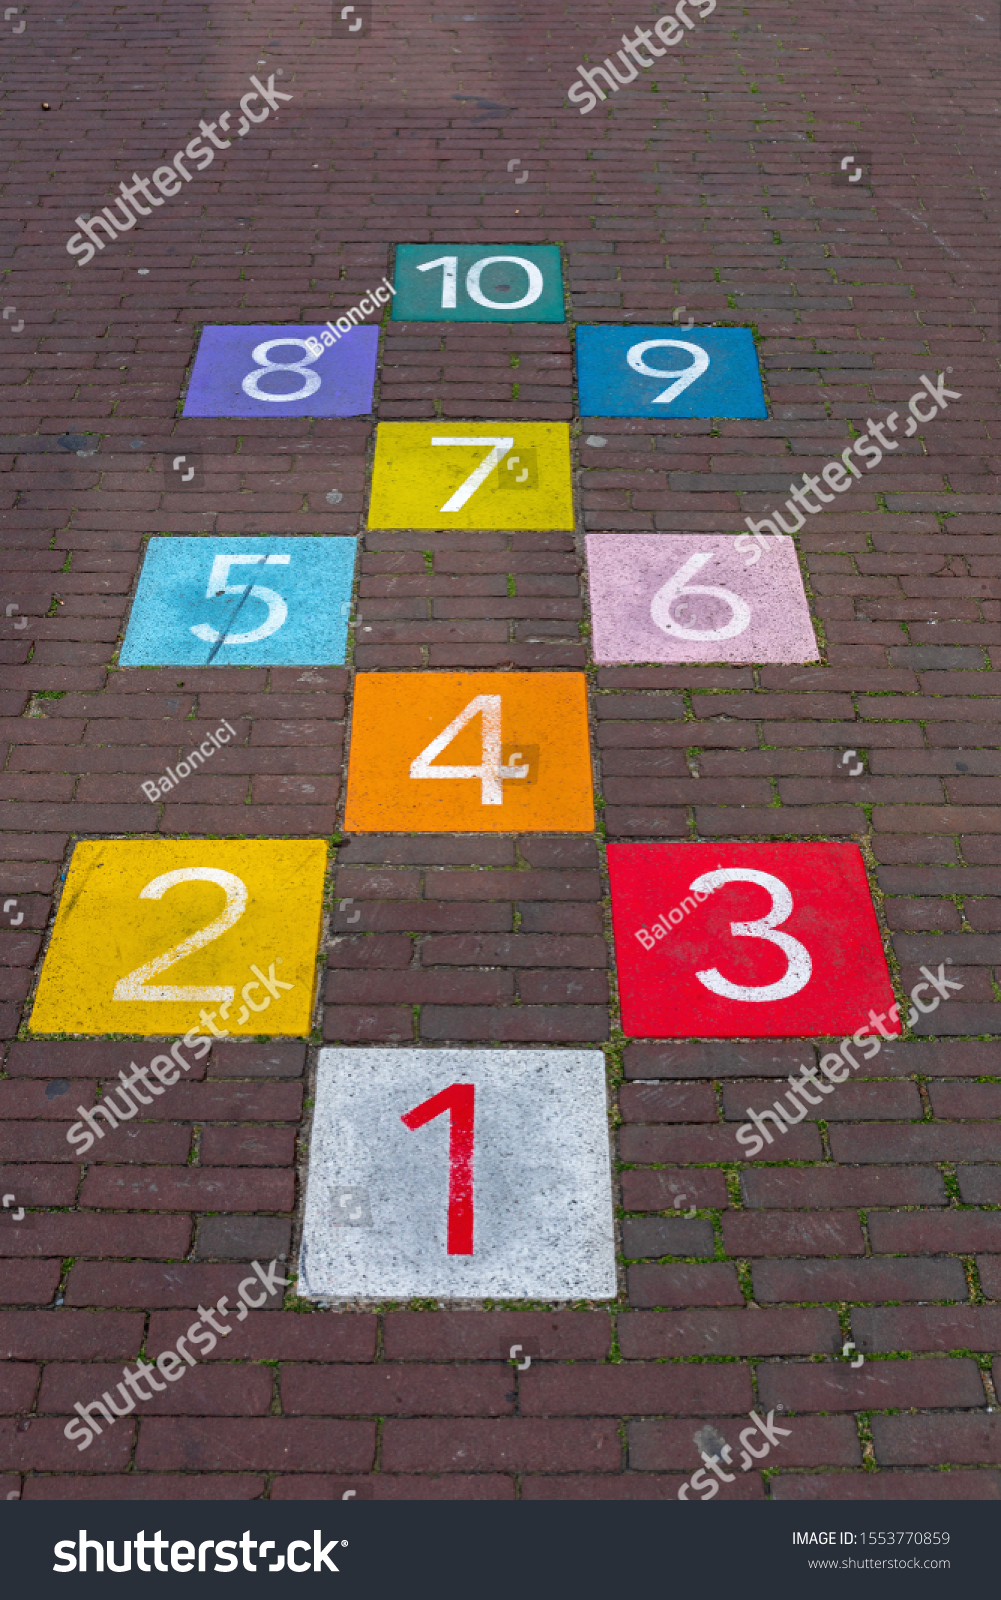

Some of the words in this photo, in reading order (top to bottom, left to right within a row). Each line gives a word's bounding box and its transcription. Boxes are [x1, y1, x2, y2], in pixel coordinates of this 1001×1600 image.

[415, 255, 544, 310] 10
[241, 338, 322, 403] 8
[626, 338, 711, 404] 9
[431, 437, 515, 512] 7
[190, 554, 291, 645] 5
[650, 552, 751, 642] 6
[409, 694, 530, 805] 4
[112, 866, 249, 1002] 2
[688, 867, 813, 1003] 3
[400, 1083, 475, 1256] 1
